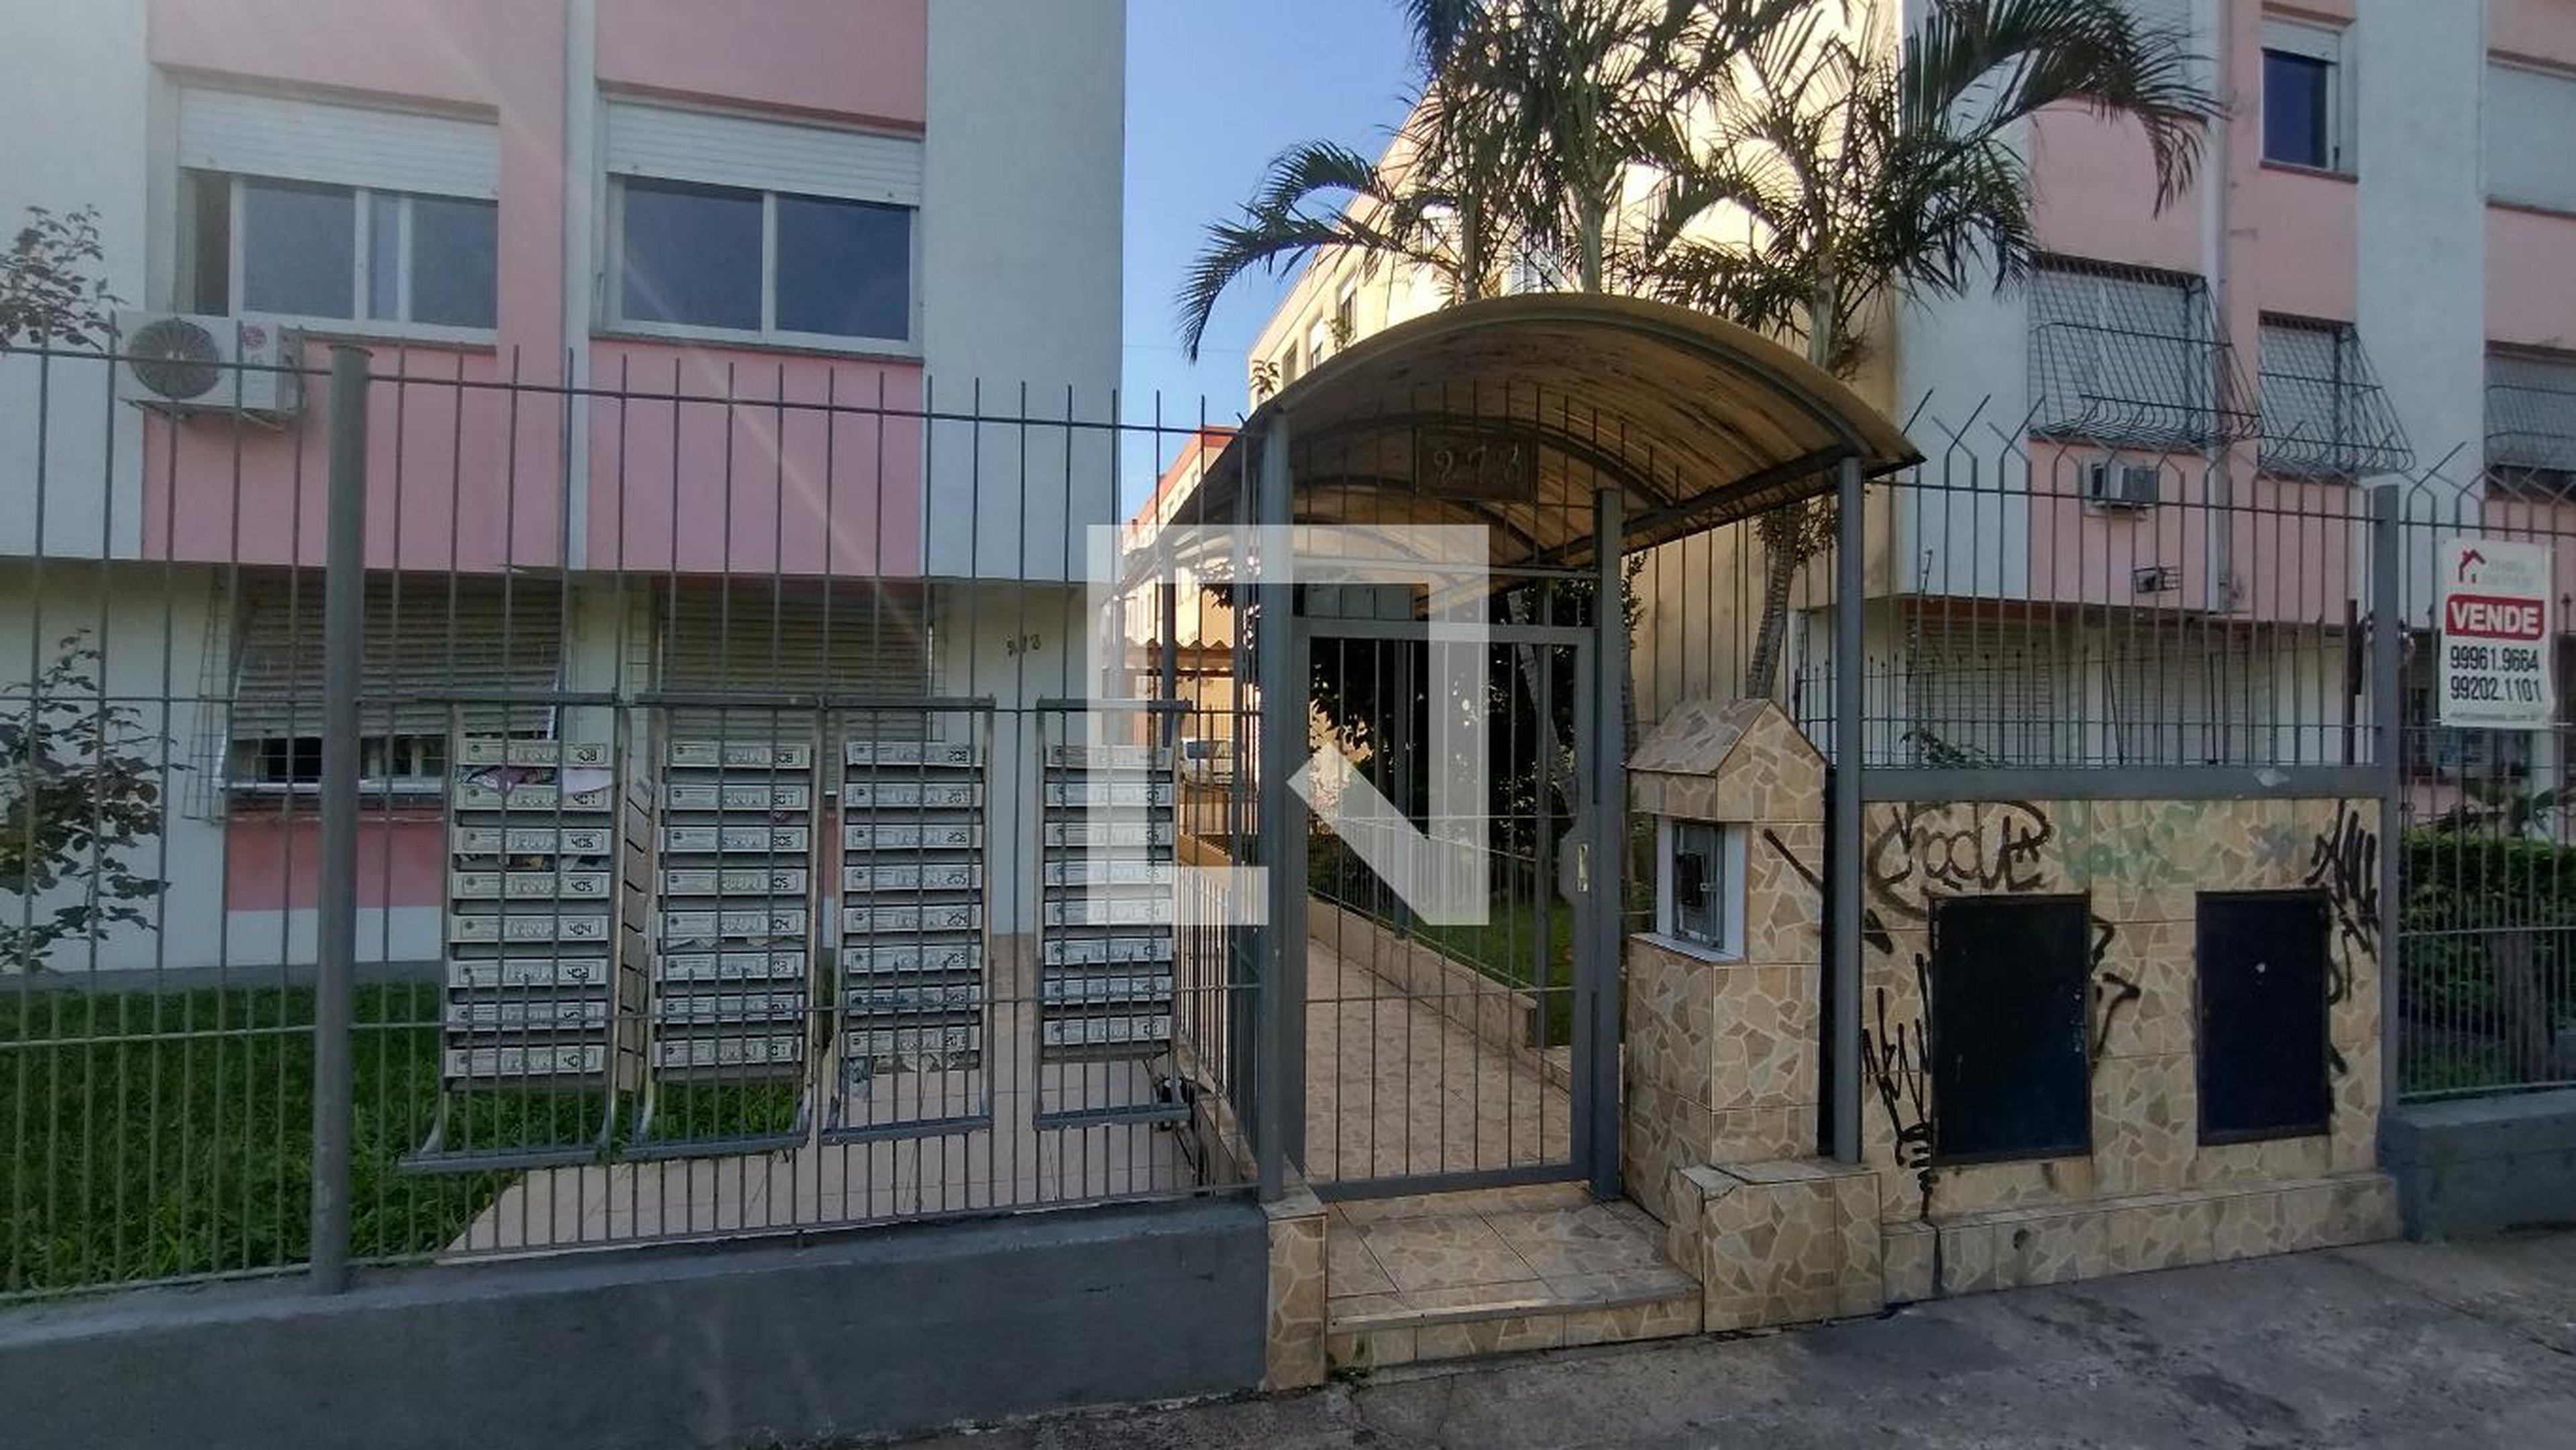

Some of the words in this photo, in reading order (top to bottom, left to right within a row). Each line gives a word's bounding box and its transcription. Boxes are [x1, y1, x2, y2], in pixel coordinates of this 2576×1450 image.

[2450, 601, 2540, 635] VENDE
[2450, 645, 2539, 673] 99961.9664
[2450, 677, 2542, 703] 99202.1101
